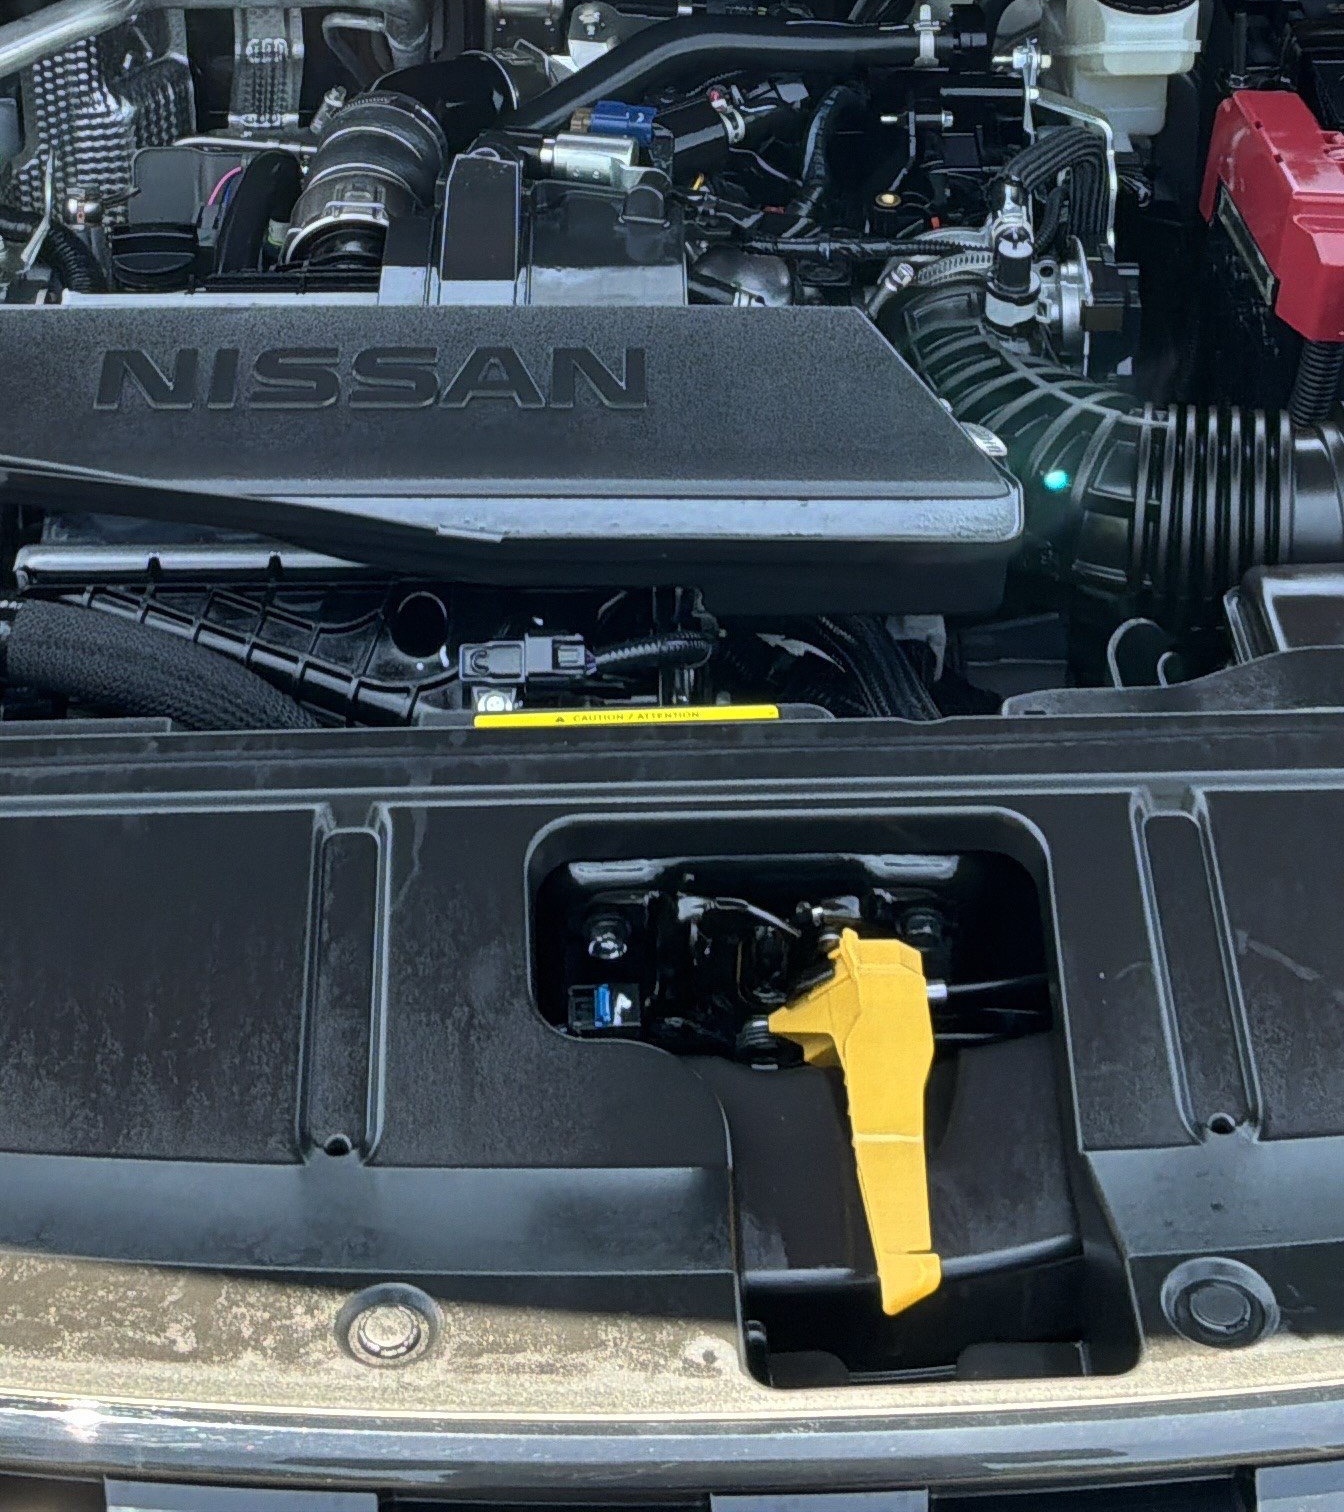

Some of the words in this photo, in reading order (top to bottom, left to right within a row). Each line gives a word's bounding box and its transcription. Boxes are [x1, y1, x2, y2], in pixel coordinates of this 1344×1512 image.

[94, 347, 648, 411] NISSAN
[573, 714, 624, 723] CAUTION
[637, 711, 700, 720] ATTENTION
